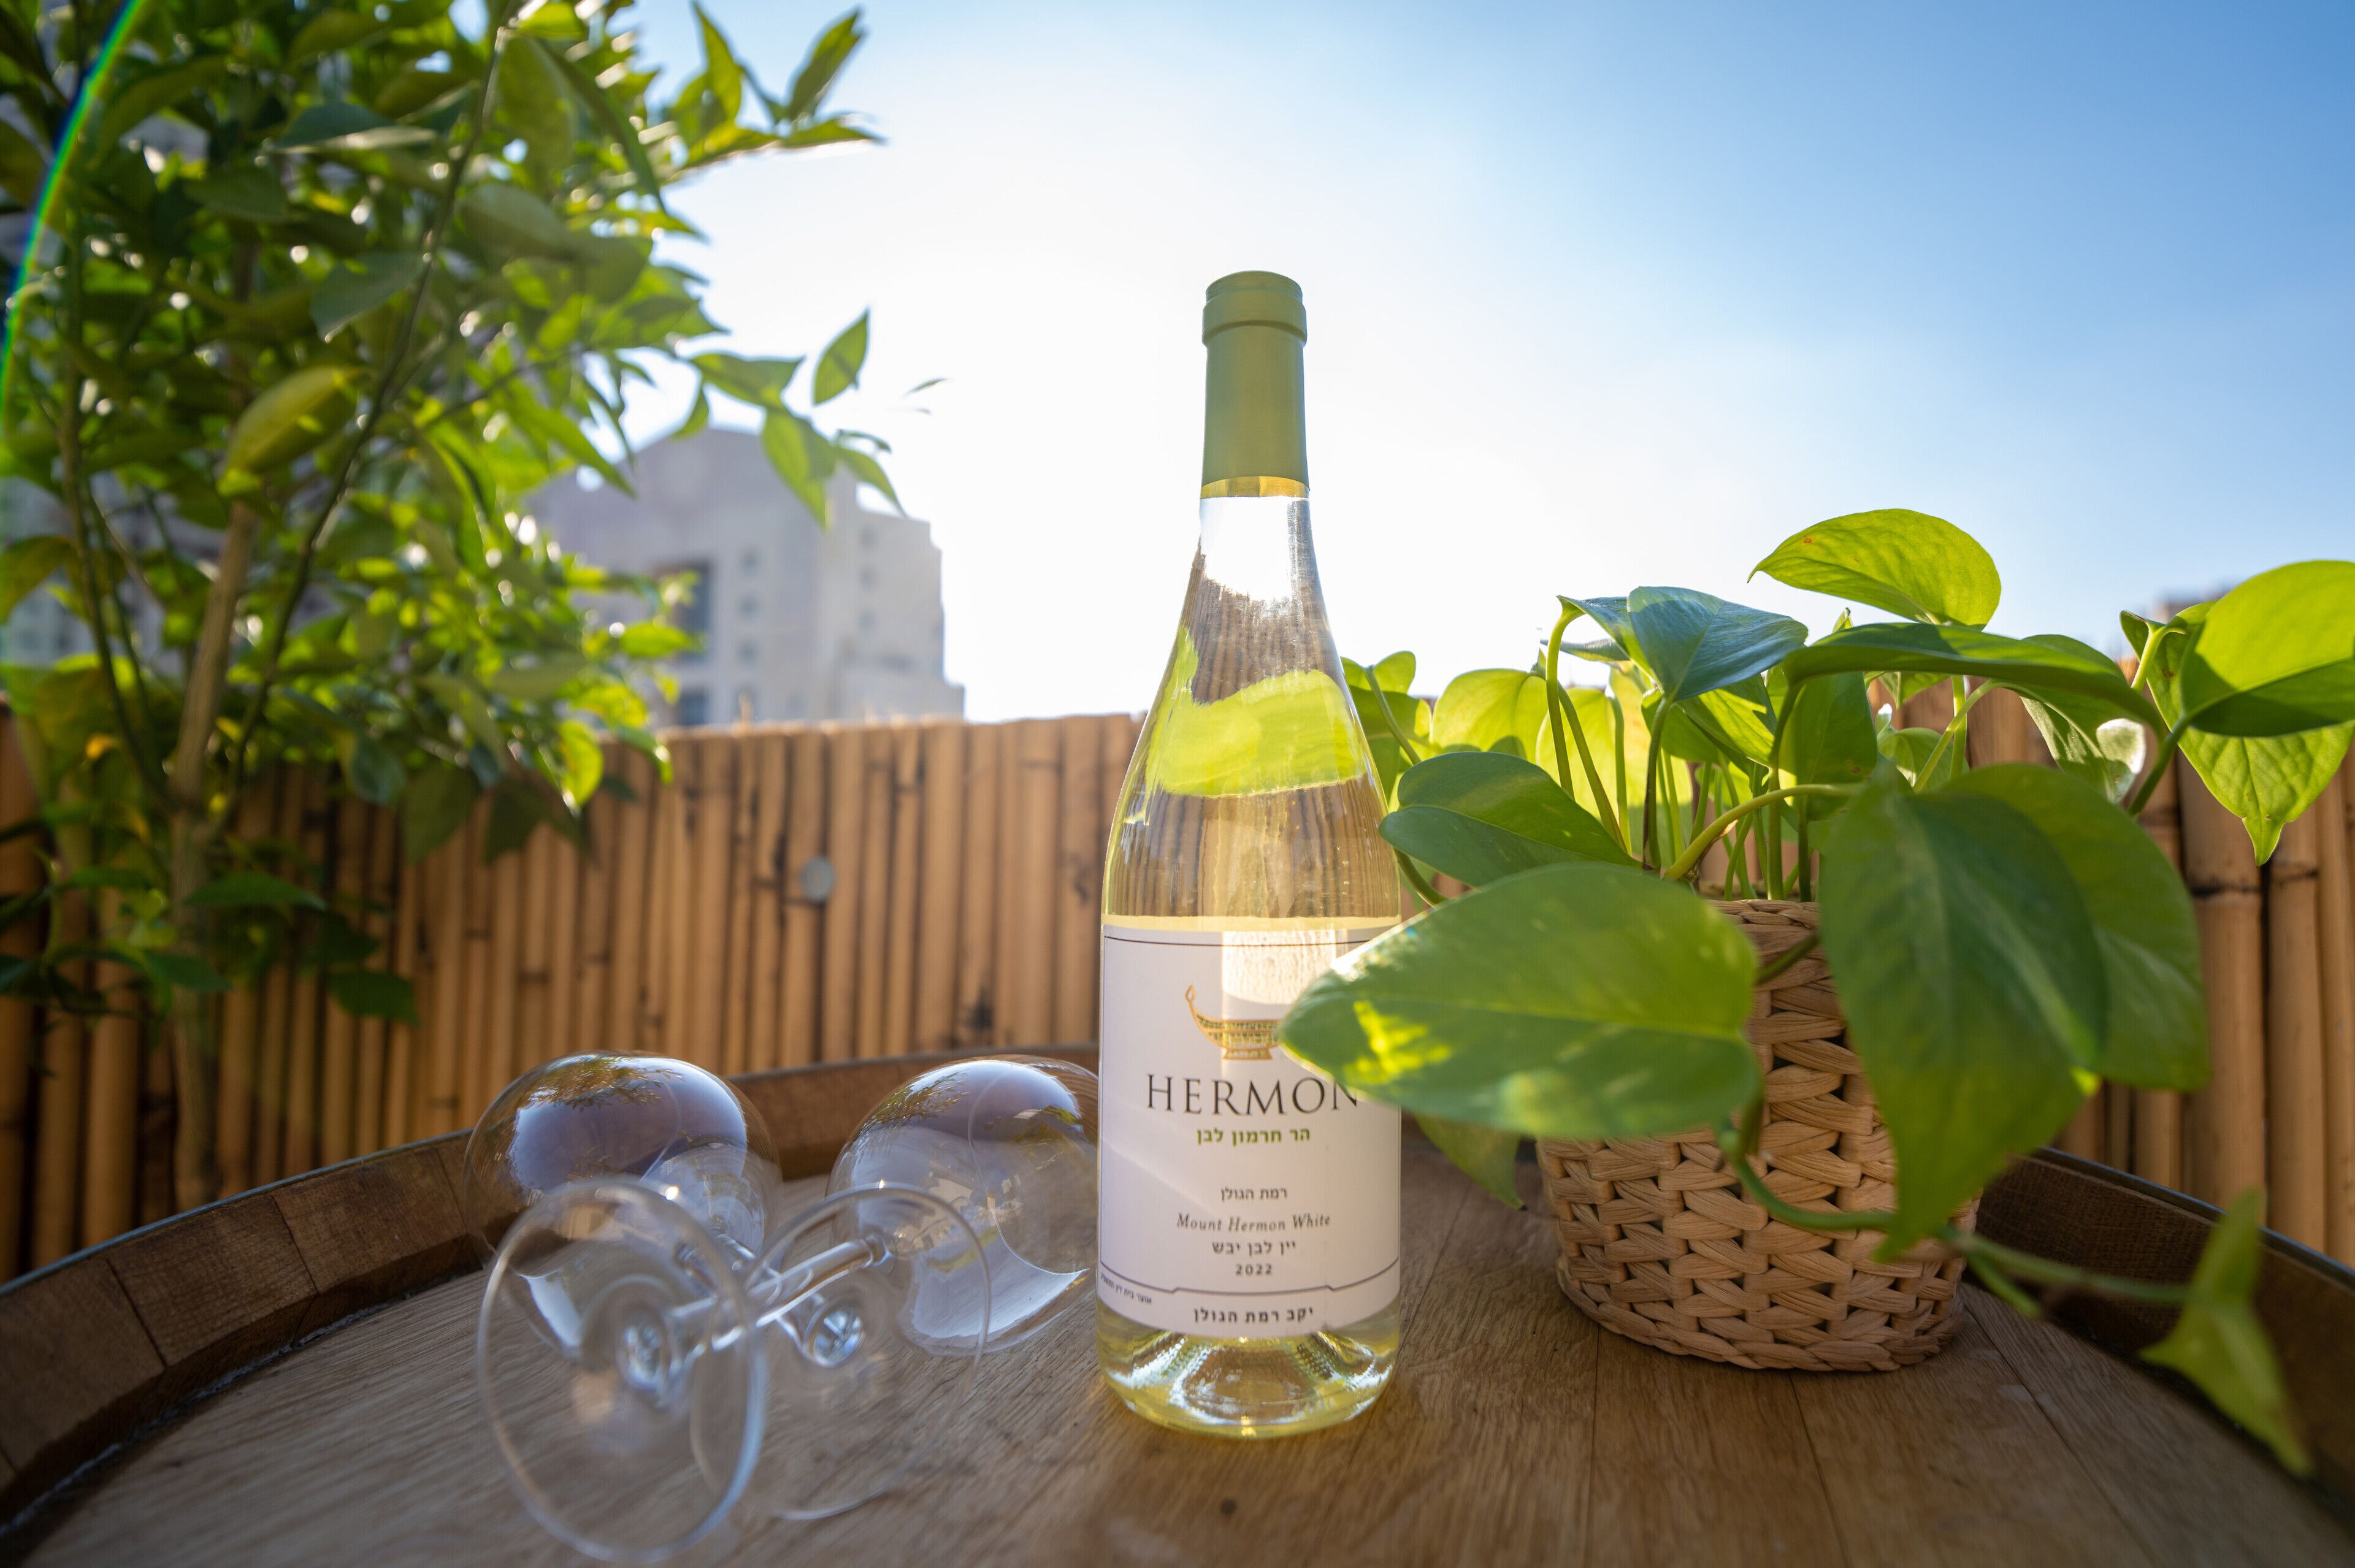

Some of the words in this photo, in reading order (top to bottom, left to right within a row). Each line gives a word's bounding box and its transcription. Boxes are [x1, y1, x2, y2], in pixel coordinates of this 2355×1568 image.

[1147, 1073, 1357, 1116] HERMON
[1197, 1127, 1223, 1145] לבן
[1231, 1128, 1282, 1147] חרמון
[1289, 1128, 1311, 1142] הר
[1220, 1186, 1254, 1203] הגולן
[1259, 1187, 1288, 1201] רמת
[1176, 1212, 1222, 1232] Mount
[1228, 1217, 1286, 1233] Hermon
[1292, 1212, 1331, 1229] White
[1212, 1240, 1241, 1255] יבש
[1247, 1239, 1273, 1256] לבן
[1279, 1240, 1296, 1256] יין
[1235, 1263, 1273, 1277] 2022
[1193, 1307, 1238, 1324] הגולן
[1245, 1310, 1279, 1324] רמת
[1286, 1307, 1313, 1323] יקב
